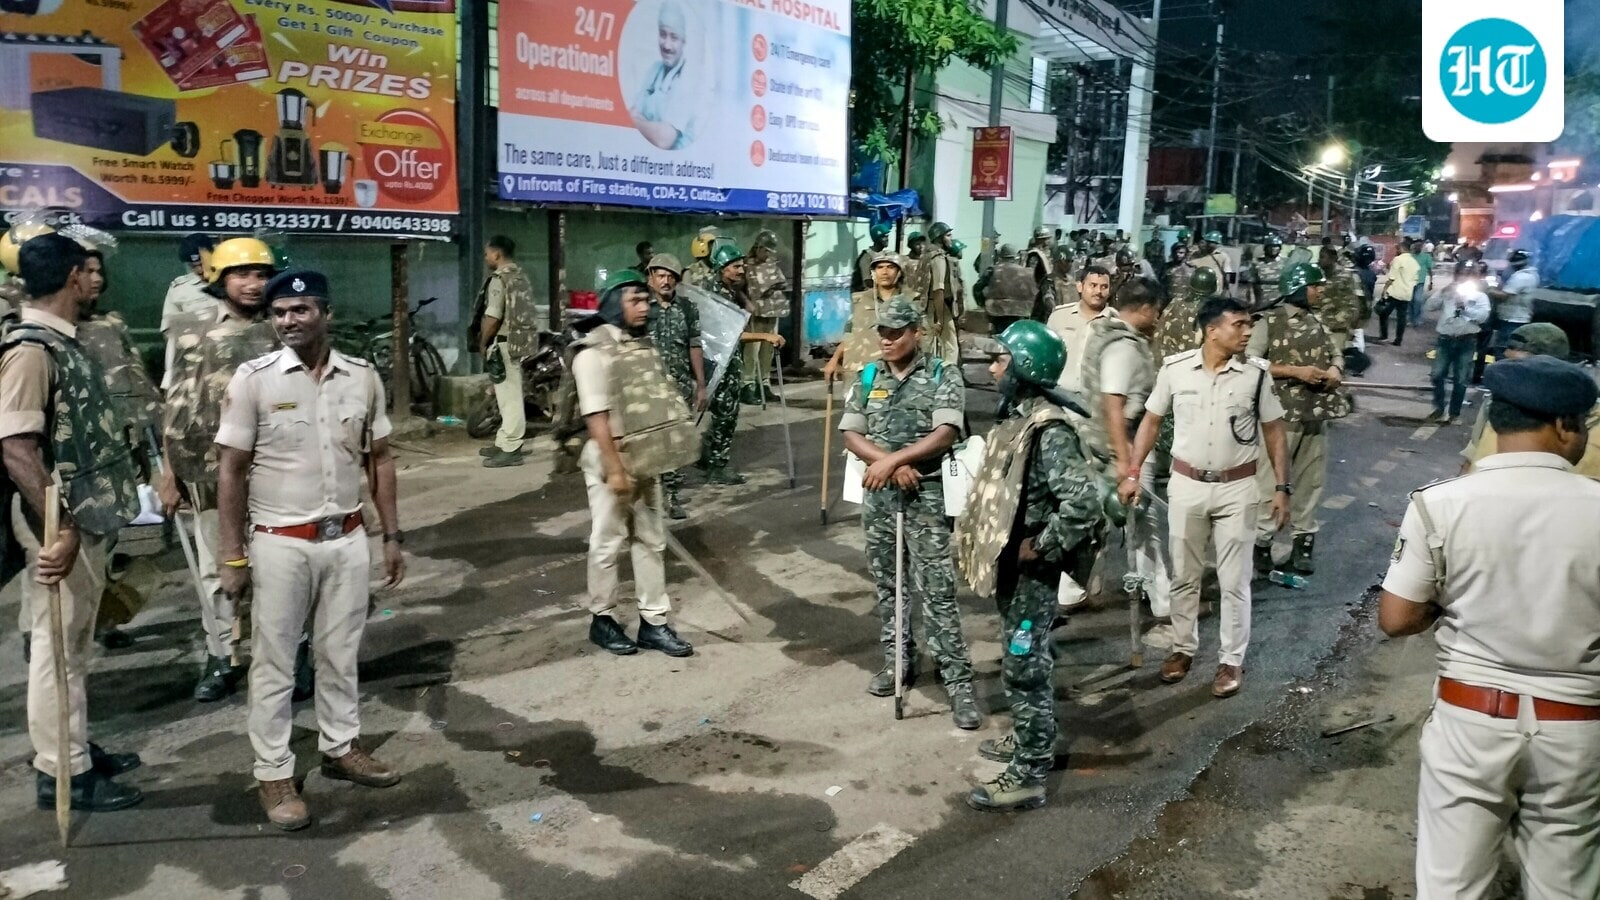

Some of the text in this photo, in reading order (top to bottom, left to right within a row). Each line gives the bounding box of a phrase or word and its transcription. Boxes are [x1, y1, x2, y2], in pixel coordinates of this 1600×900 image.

[326, 8, 375, 25] 5000/-
[380, 18, 443, 36] Purchase
[575, 6, 615, 41] 24/7
[771, 0, 840, 30] HOSPITAL
[277, 17, 306, 29] Get
[326, 24, 353, 37] Gift
[363, 31, 419, 47] Coupon
[328, 44, 388, 69] Win
[516, 32, 614, 77] Operational
[277, 61, 432, 99] PRIZES
[361, 123, 424, 145] Exchange
[92, 157, 118, 167] Free
[122, 158, 156, 170] Smart
[374, 149, 442, 179] Offer
[504, 143, 714, 180] The same care, Just a different address!
[0, 184, 84, 208] CALS
[517, 177, 563, 193] Infront
[565, 179, 580, 193] of
[582, 180, 607, 194] Fire
[608, 182, 651, 200] station,
[653, 186, 688, 202] CDA-2,
[780, 193, 806, 209] 9124
[808, 194, 826, 209] 102
[122, 210, 451, 232] Call us : 9861323371 / 9040643398
